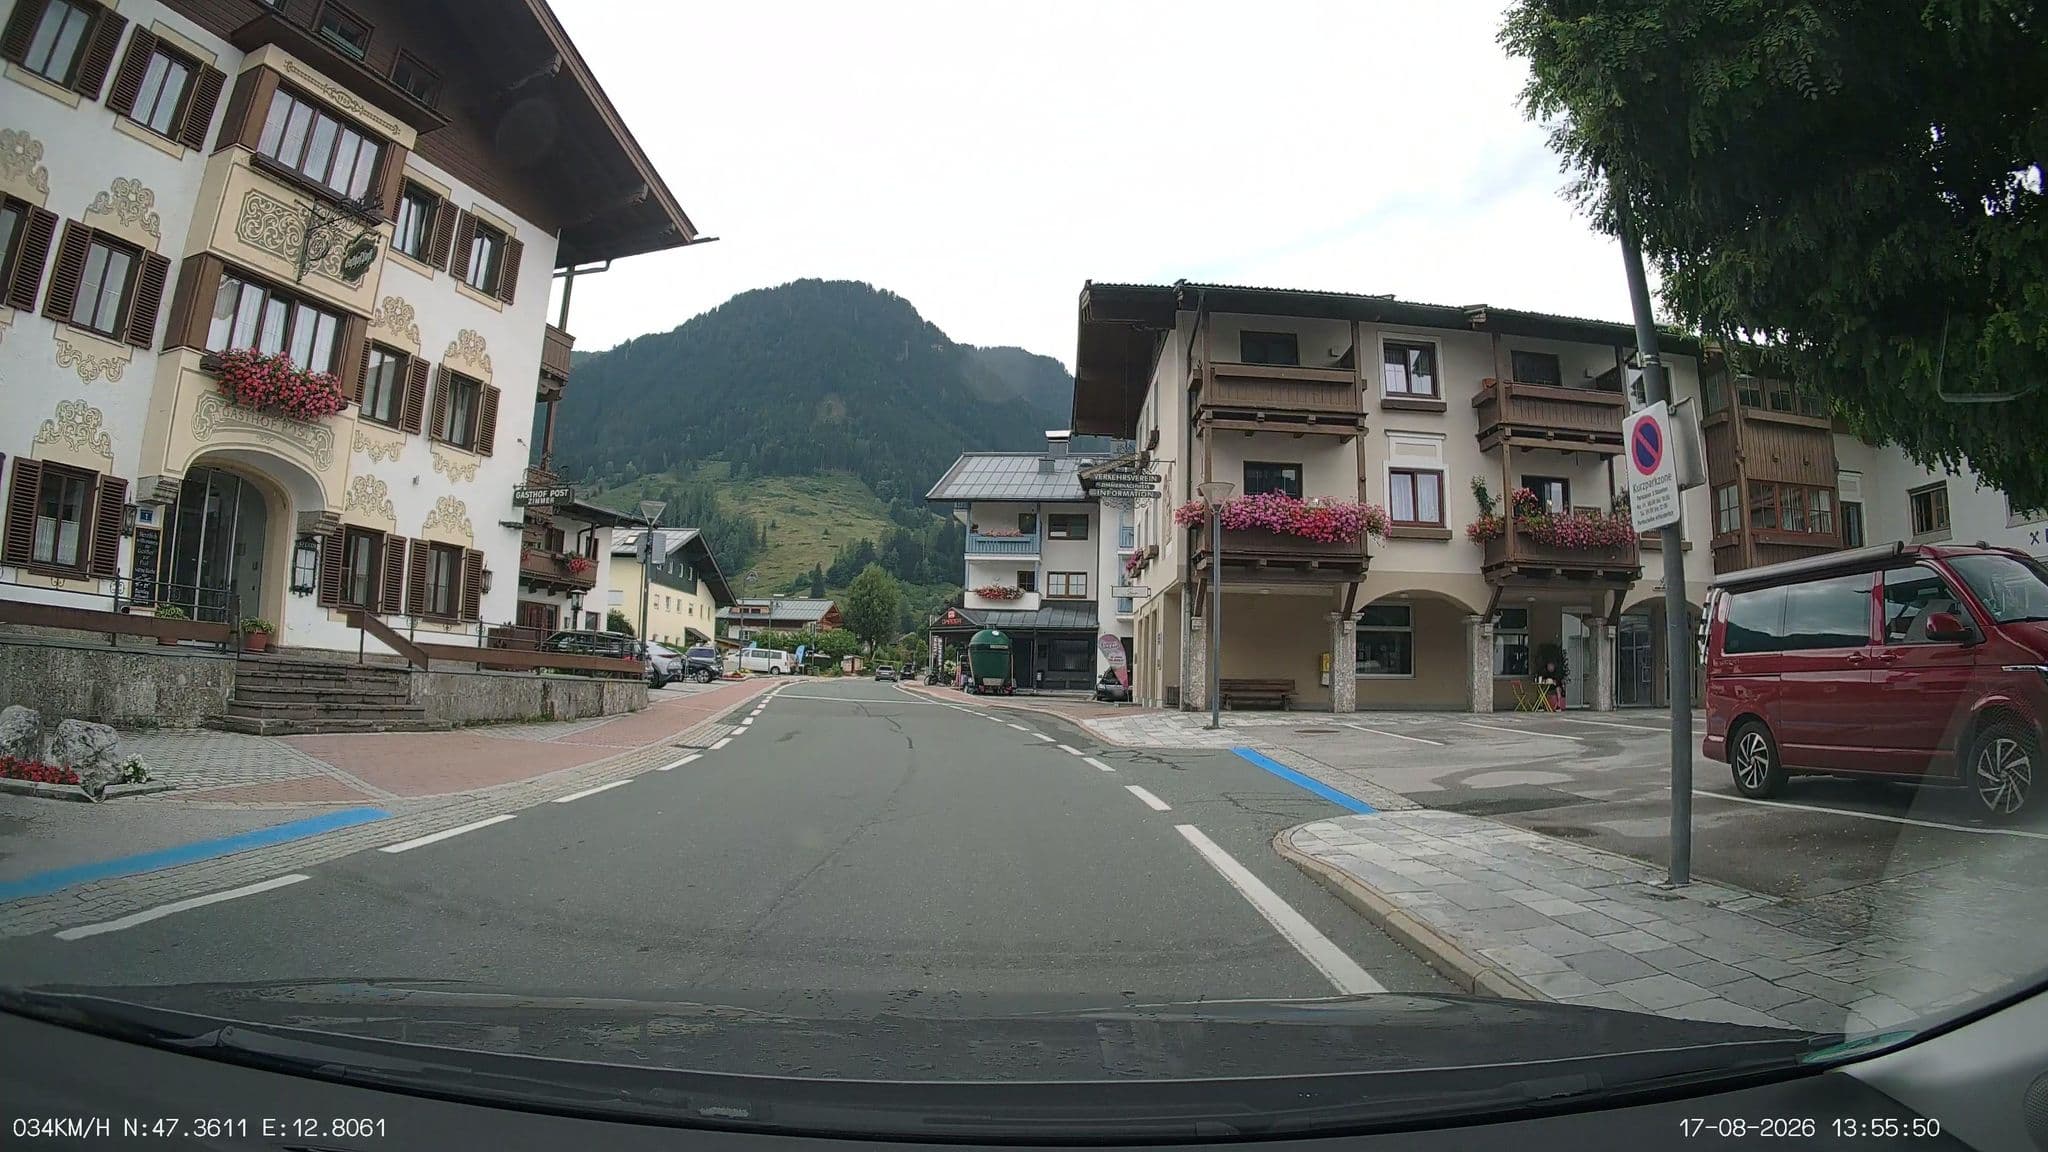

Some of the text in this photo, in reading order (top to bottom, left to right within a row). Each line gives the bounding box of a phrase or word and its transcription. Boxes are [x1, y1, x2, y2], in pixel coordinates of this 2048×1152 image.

[222, 407, 278, 430] GASTHOF
[1094, 473, 1158, 482] VERKEHRSVEREIN
[515, 488, 570, 499] GASTHOF POST
[1096, 489, 1154, 498] INFORMATION
[528, 497, 555, 505] ZIMMER
